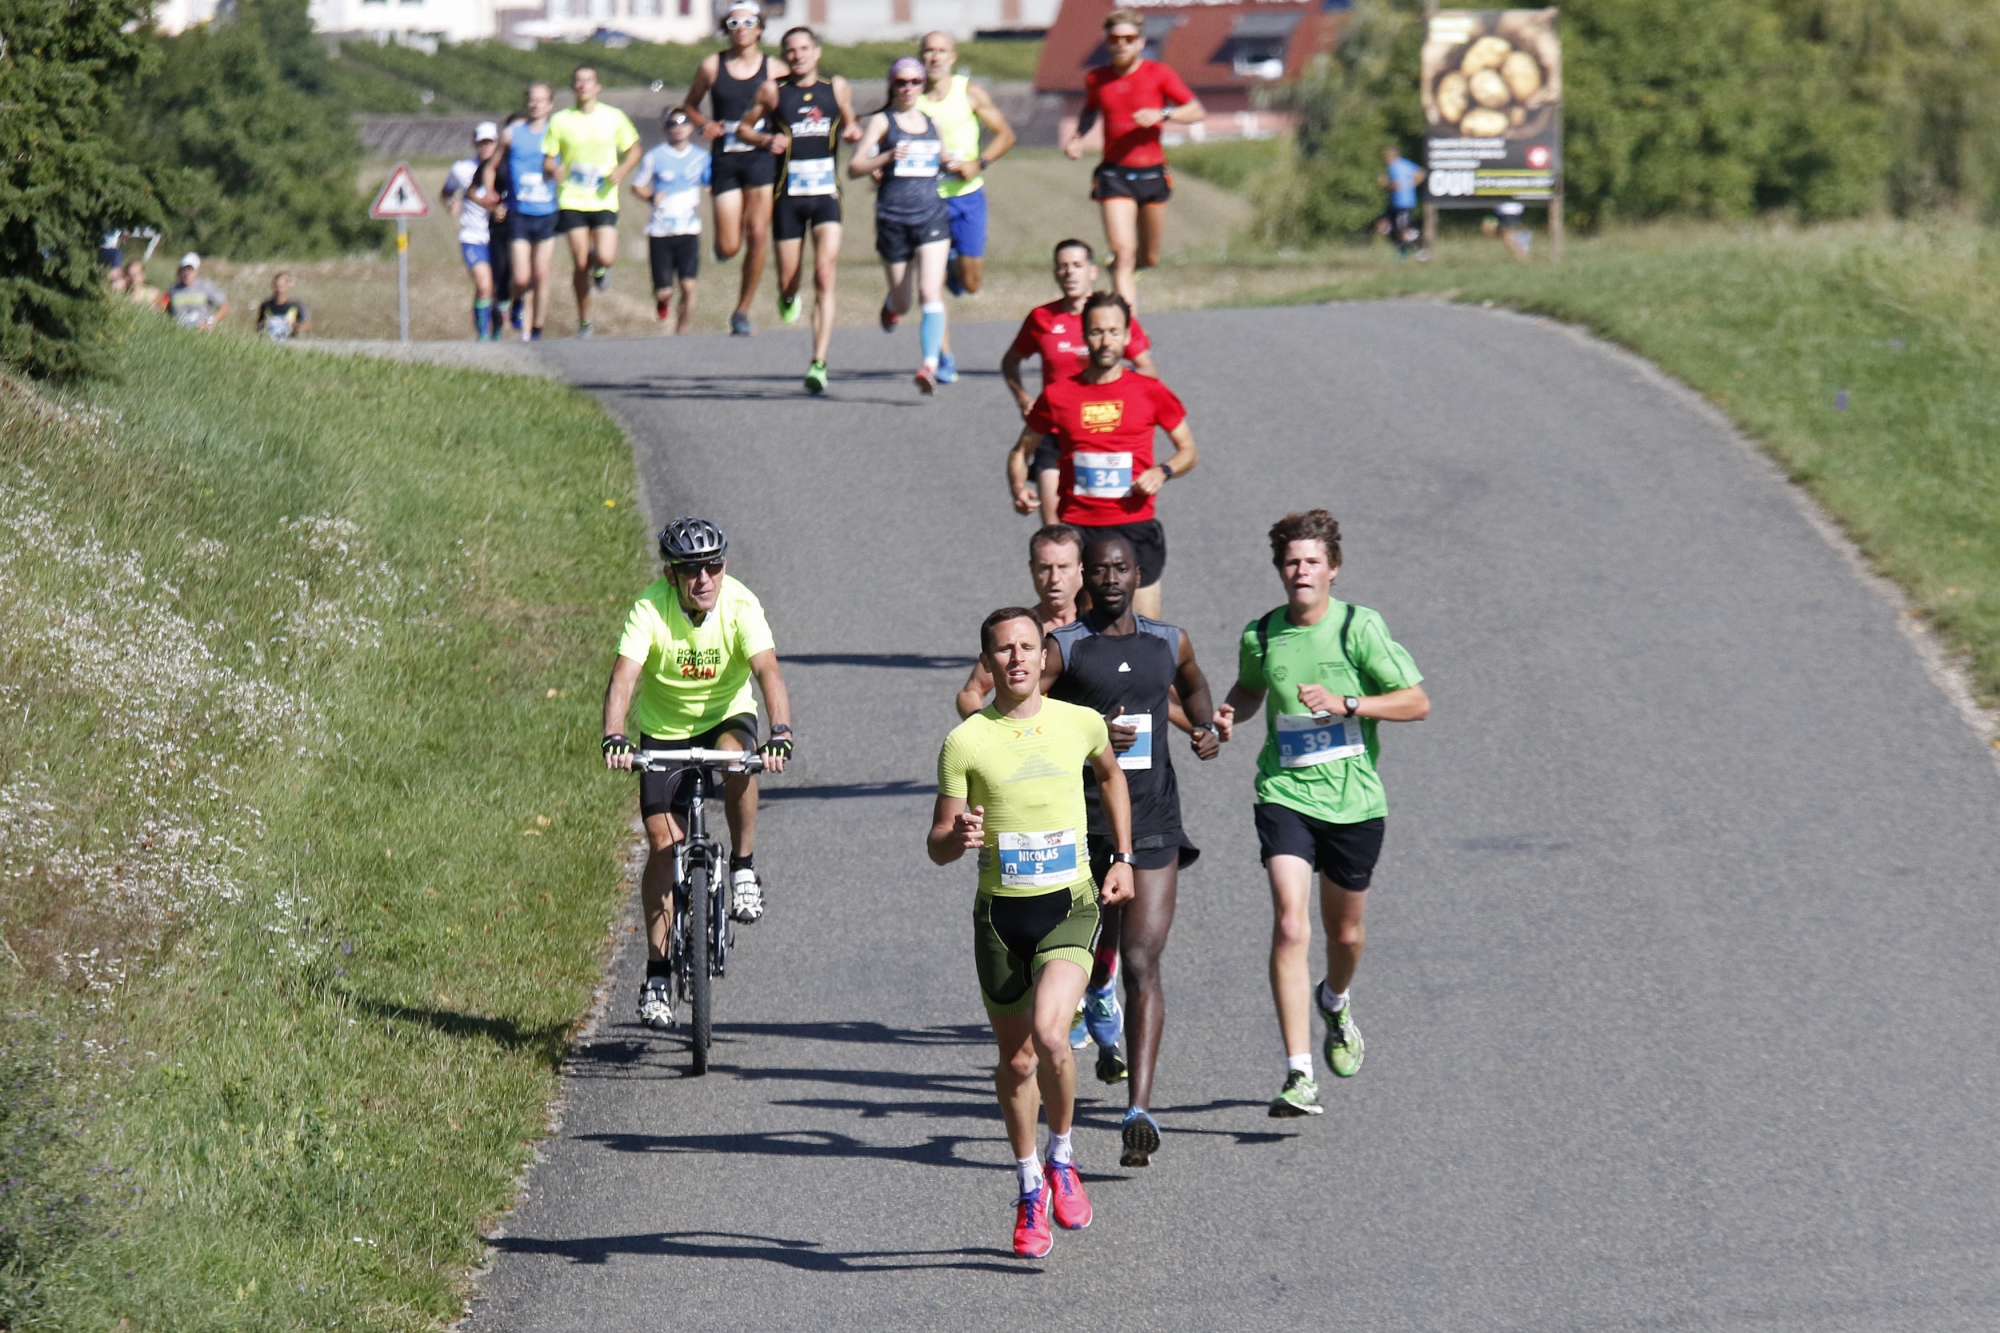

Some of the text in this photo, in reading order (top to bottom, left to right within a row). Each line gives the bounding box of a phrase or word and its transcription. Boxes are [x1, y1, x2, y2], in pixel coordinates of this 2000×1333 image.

[1094, 469, 1120, 487] 34
[678, 647, 721, 658] ROMANDE
[676, 656, 722, 667] ENERGIE
[1302, 730, 1332, 753] 39
[1018, 847, 1059, 862] NICOLAS
[1035, 862, 1045, 874] 5
